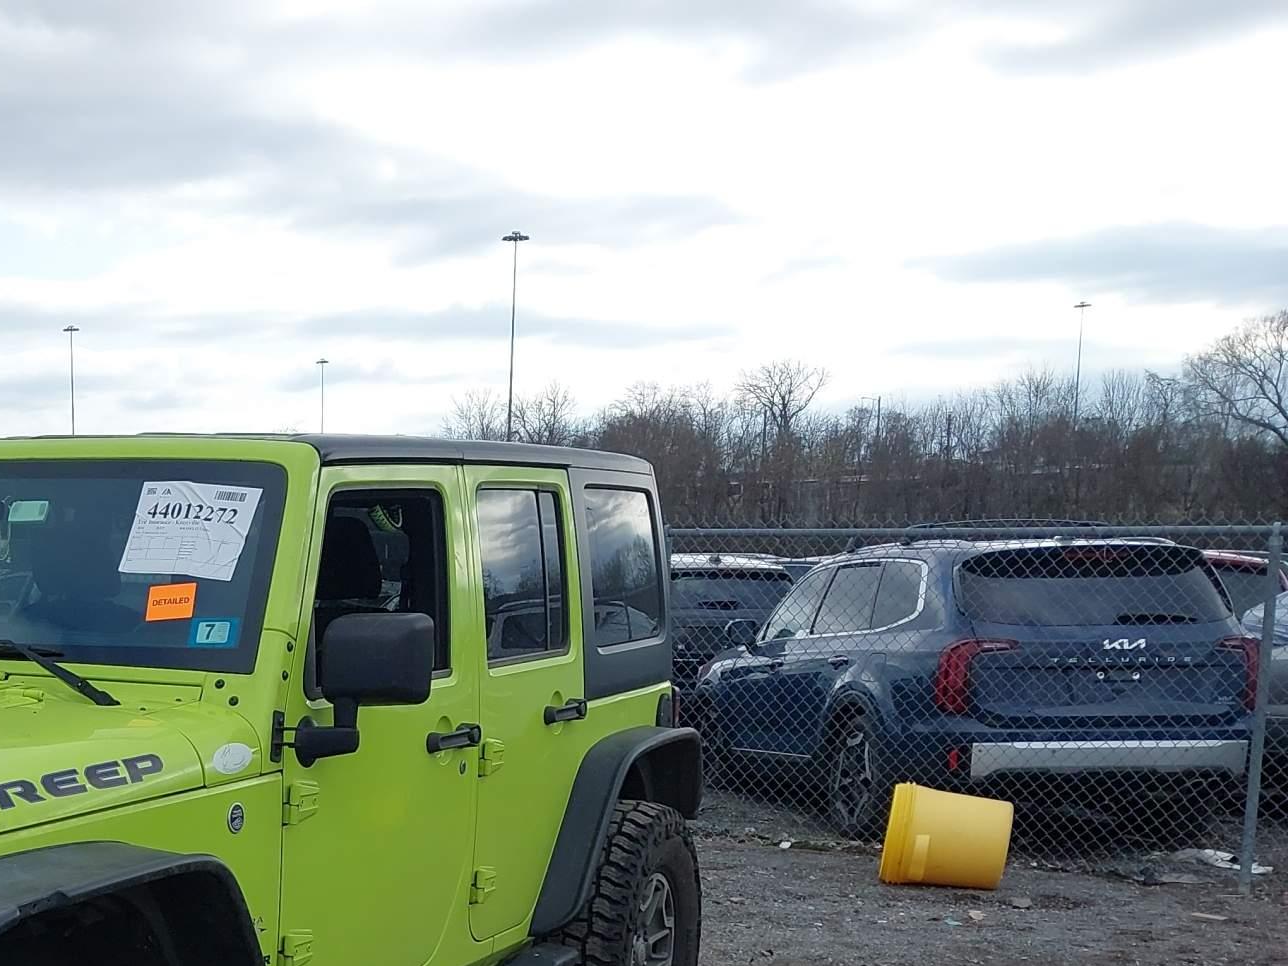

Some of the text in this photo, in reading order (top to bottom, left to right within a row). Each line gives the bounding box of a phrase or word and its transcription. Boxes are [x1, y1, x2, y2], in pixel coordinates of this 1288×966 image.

[147, 502, 239, 525] 44012272
[152, 596, 190, 607] DETAILED
[205, 623, 216, 641] 7
[1103, 638, 1147, 650] KIA
